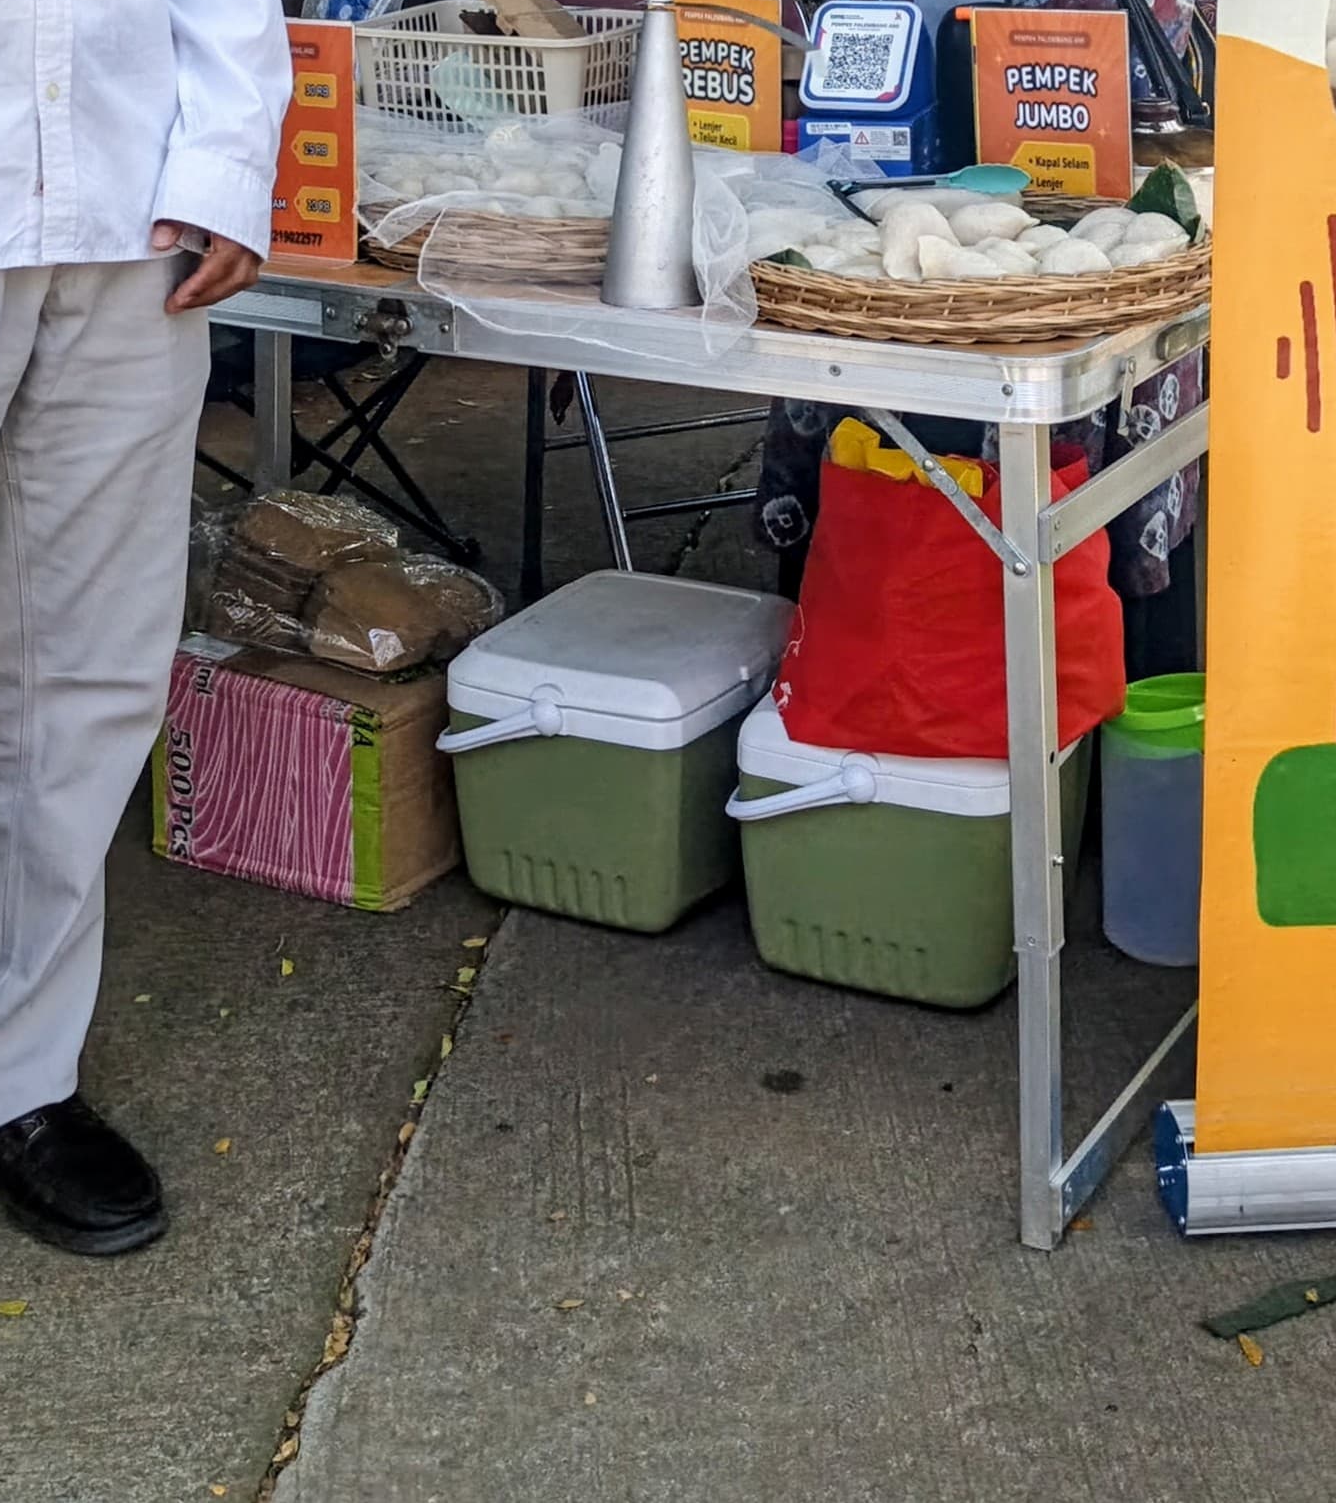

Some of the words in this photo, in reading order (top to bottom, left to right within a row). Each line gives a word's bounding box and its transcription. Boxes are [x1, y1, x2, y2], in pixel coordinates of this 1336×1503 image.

[679, 38, 755, 73] PEMPEK
[681, 67, 754, 104] REBUS
[1006, 65, 1097, 96] PEMPEK
[699, 120, 724, 133] Lenjer
[1016, 102, 1090, 131] JUMBO
[1035, 157, 1060, 170] Kapal
[1062, 157, 1090, 170] Selam
[1036, 177, 1064, 191] Lenjer
[170, 726, 193, 799] 500
[170, 802, 193, 860] Pcs
